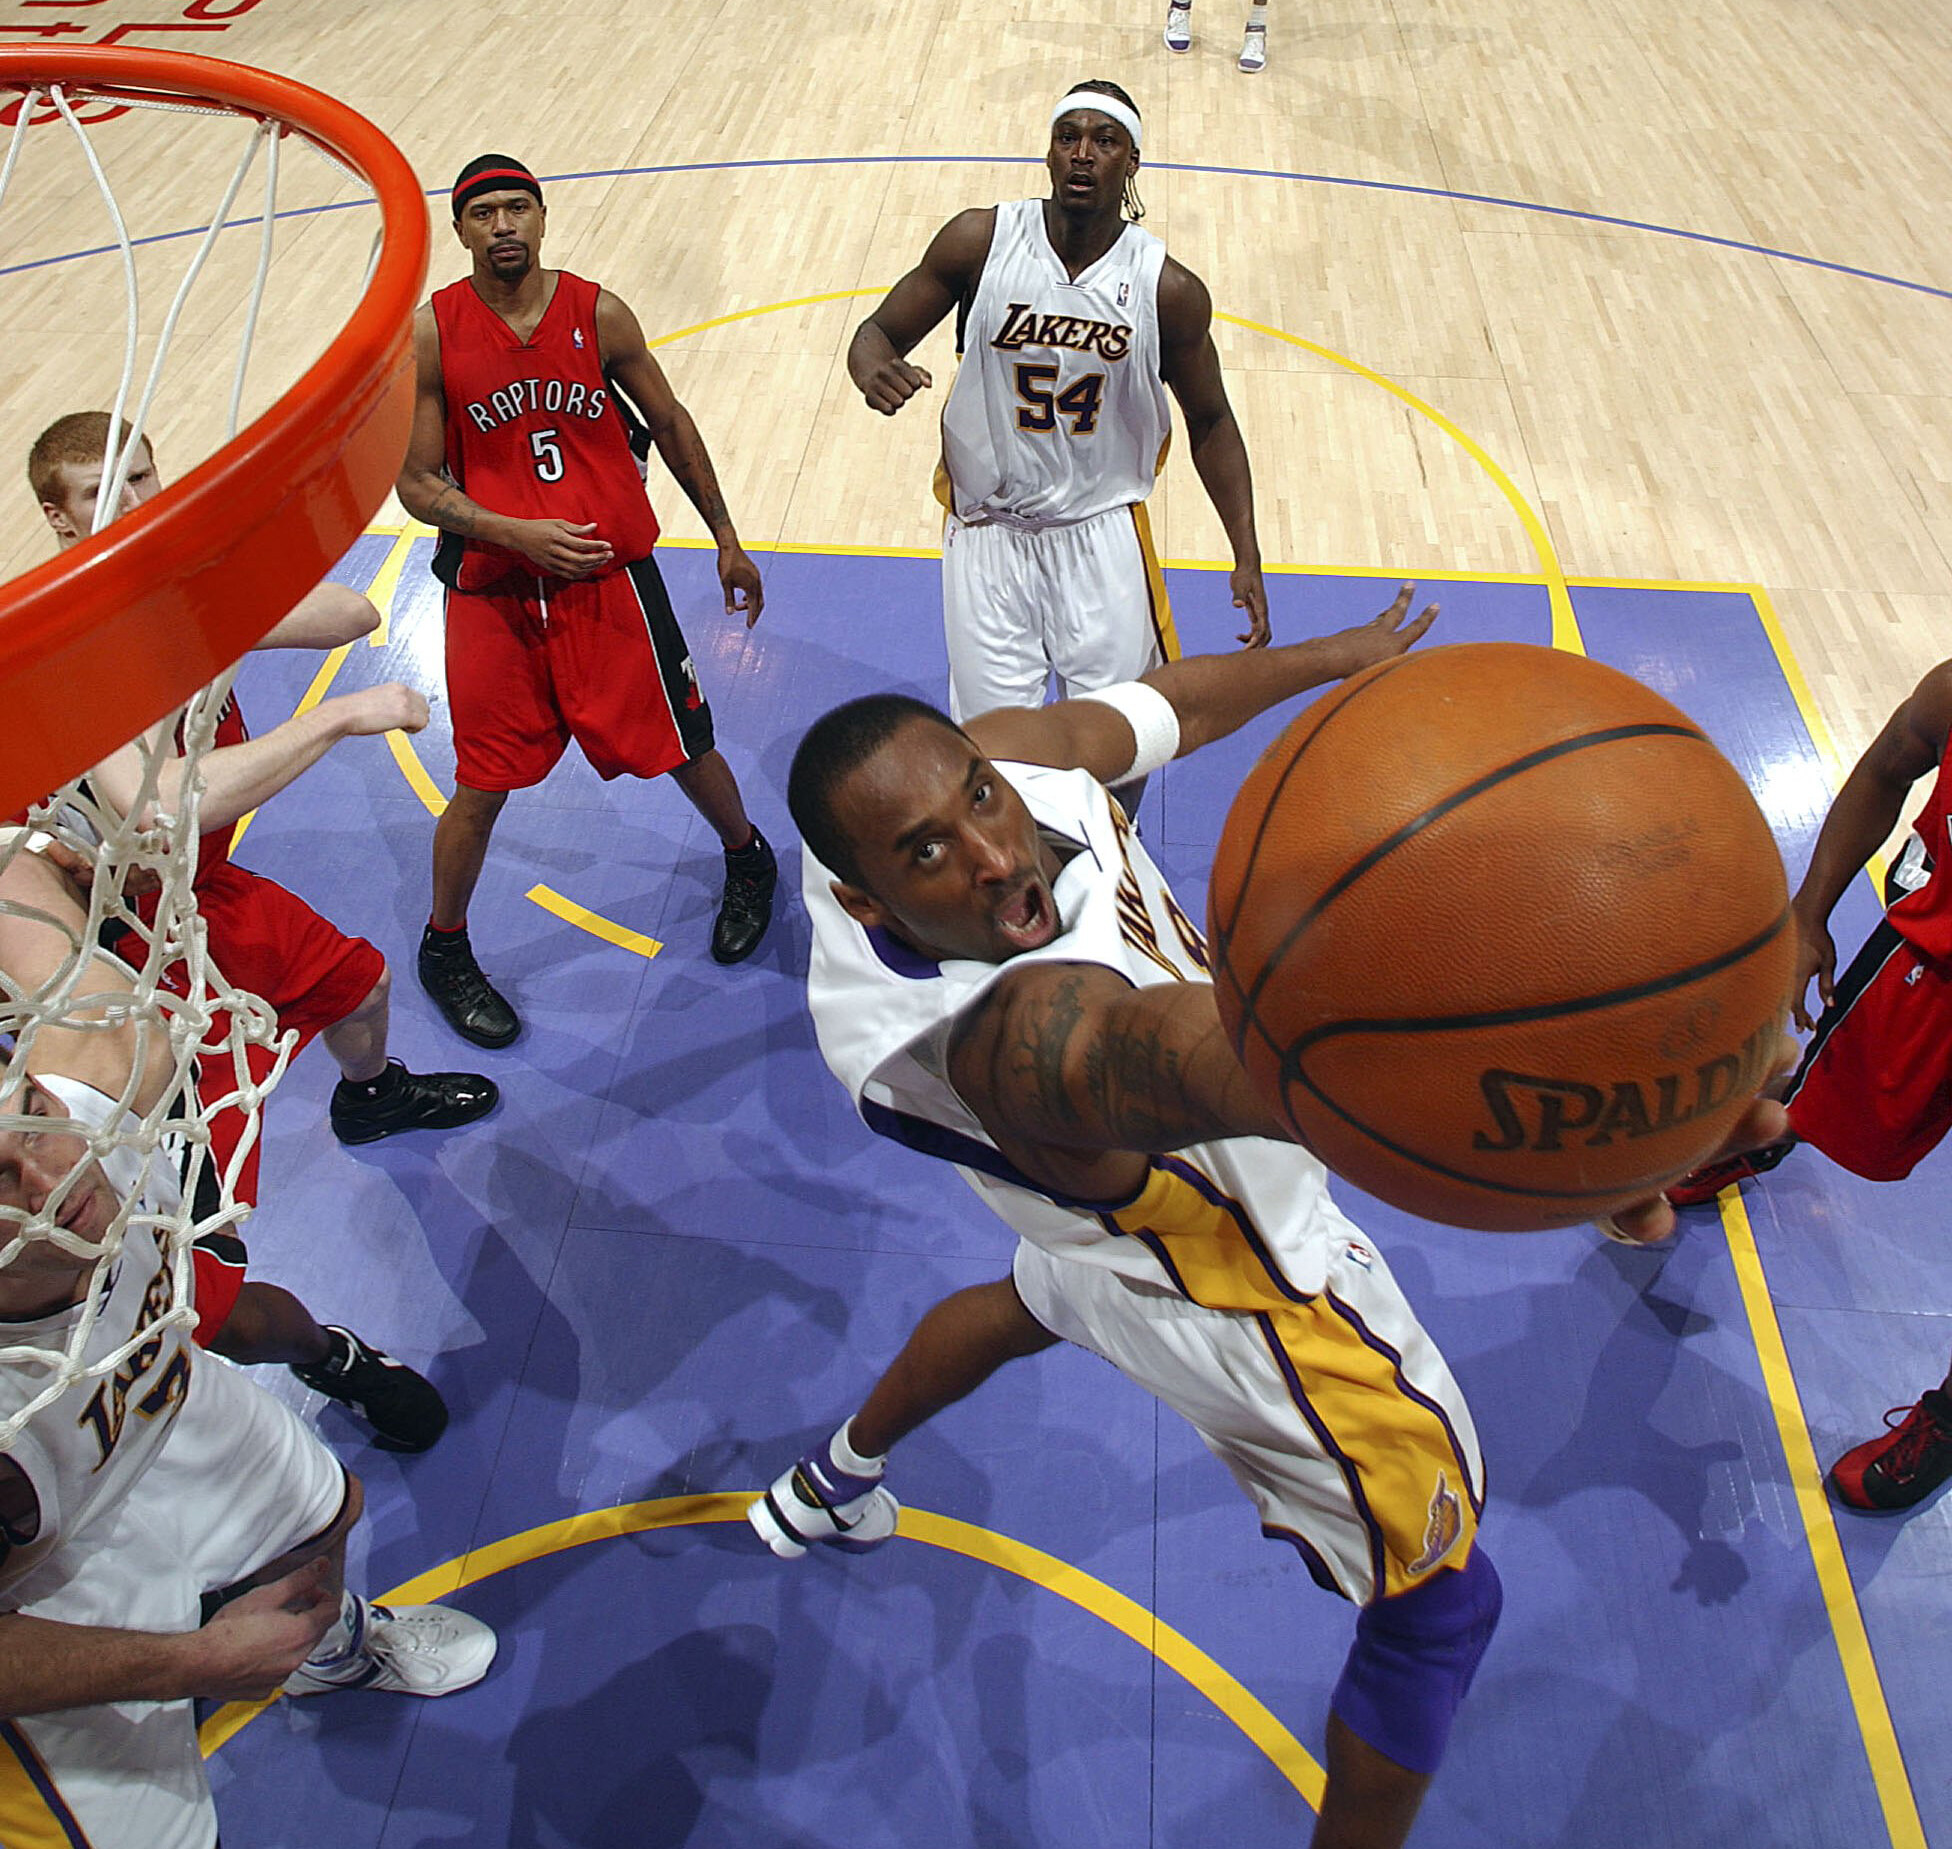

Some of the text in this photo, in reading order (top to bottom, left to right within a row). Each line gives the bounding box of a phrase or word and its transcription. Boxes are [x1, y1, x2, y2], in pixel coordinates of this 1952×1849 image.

[990, 302, 1133, 363] LAKERS
[467, 378, 607, 433] RAPTORS
[1013, 362, 1106, 436] 54
[529, 429, 565, 485] 5
[1472, 1020, 1782, 1152] SPALDI
